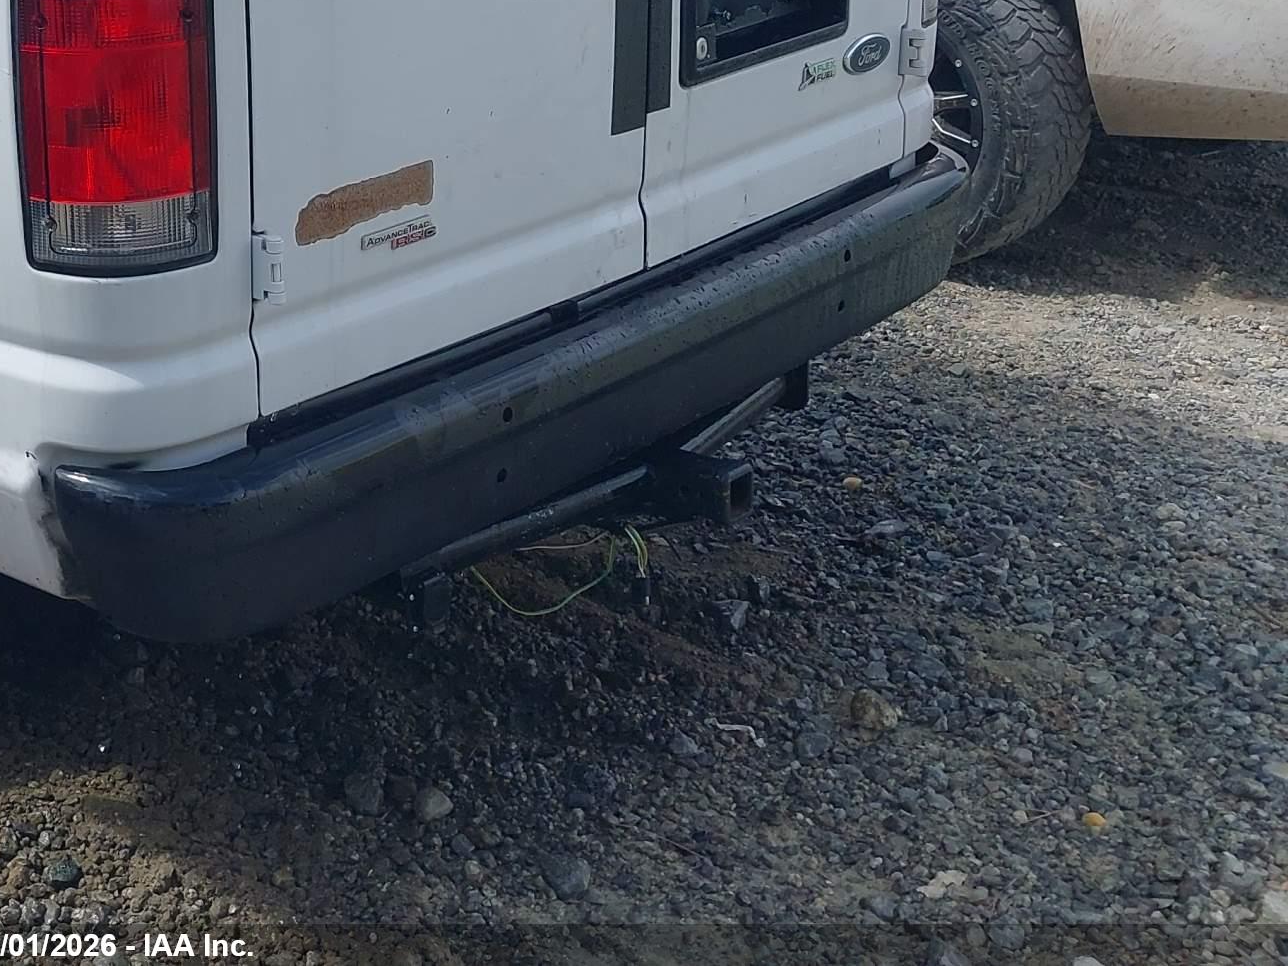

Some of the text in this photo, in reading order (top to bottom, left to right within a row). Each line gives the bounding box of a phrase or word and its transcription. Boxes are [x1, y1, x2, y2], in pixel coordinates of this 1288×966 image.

[858, 42, 883, 67] Ford
[816, 59, 835, 72] FLEX
[816, 70, 835, 82] FUEL
[390, 226, 437, 251] RSC
